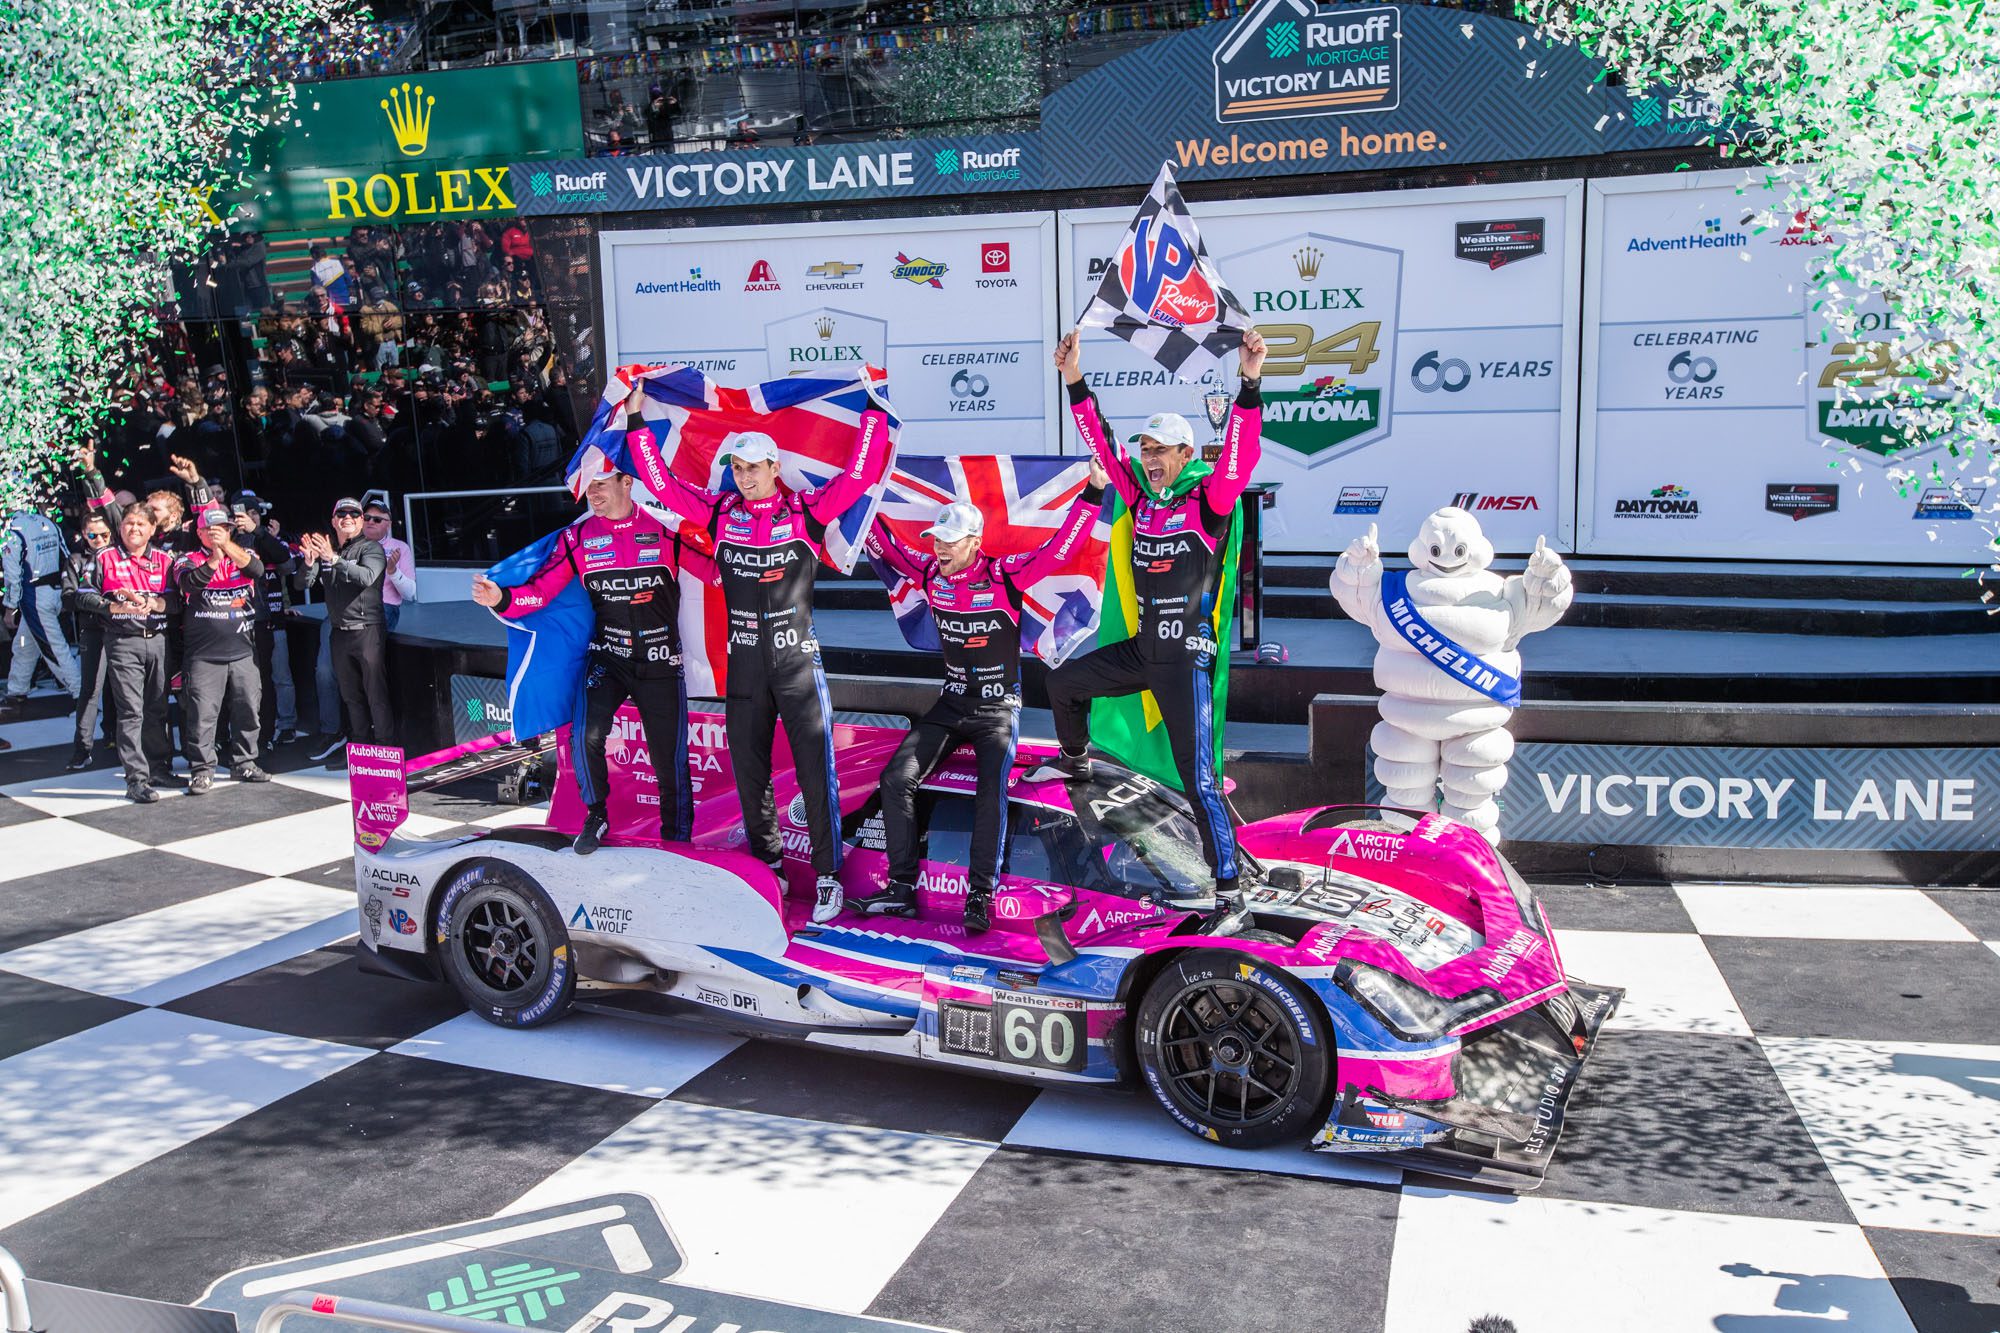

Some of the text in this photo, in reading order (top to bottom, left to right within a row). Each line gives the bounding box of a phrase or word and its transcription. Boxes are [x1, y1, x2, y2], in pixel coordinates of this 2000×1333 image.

[1306, 15, 1390, 49] Ruoff
[1306, 46, 1390, 67] MORTGAGE
[1225, 65, 1391, 98] VICTORY LANE
[1175, 126, 1448, 168] Welcome home.
[963, 148, 1021, 169] Ruoff
[556, 170, 607, 192] Ruoff
[626, 152, 914, 200] VICTORY LANE
[963, 168, 1021, 182] MORTGAGE
[323, 166, 517, 220] ROLEX
[556, 190, 608, 204] MORTGAGE
[895, 264, 947, 279] SUNOCO
[744, 281, 782, 292] AXALTA
[805, 281, 865, 292] CHEVROLET
[975, 279, 1018, 289] TOYOTA
[1156, 284, 1216, 318] Racing
[1253, 288, 1365, 313] ROLEX
[1633, 330, 1759, 347] CELEBRATING
[789, 346, 863, 362] ROLEX
[1237, 321, 1382, 376] 24
[921, 351, 1020, 367] CELEBRATING
[1410, 350, 1554, 394] 60 YEARS
[1664, 386, 1725, 400] YEARS
[948, 399, 996, 413] YEARS
[638, 434, 666, 492] AutoNation
[1476, 496, 1540, 511] IMSA
[1614, 499, 1700, 514] DAYTONA
[732, 549, 799, 568] ACURA
[1146, 559, 1176, 573] S
[601, 575, 665, 592] ACURA
[758, 567, 786, 583] S
[772, 619, 789, 628] JARVIS
[940, 619, 1002, 634] ACURA
[1157, 619, 1184, 640] 60
[738, 631, 759, 640] ARCTIC
[773, 628, 798, 649] 60
[963, 635, 990, 649] S
[647, 645, 670, 662] 60
[1389, 597, 1501, 693] MICHELIN
[981, 682, 1005, 699] 60
[350, 744, 401, 761] AutoNation
[631, 748, 723, 773] ARA
[1537, 772, 1975, 822] VICTORY LANE
[370, 802, 398, 815] ARCTIC
[374, 811, 398, 823] WOLF
[780, 830, 814, 855] CUR
[1354, 832, 1406, 851] ARCTIC
[1360, 846, 1400, 864] WOLF
[371, 869, 421, 887] ACURA
[371, 882, 411, 899] Type S
[440, 869, 480, 918] MICHELIN
[590, 905, 633, 922] ARCTIC
[1388, 900, 1430, 941] ACURA
[597, 919, 629, 934] WOLF
[1479, 930, 1535, 985] AutoNation
[521, 973, 563, 1023] MICHELIN
[696, 990, 758, 1012] AERO DPi
[994, 990, 1084, 1010] WeatherTech
[1262, 977, 1313, 1040] MICHELIN
[1004, 1007, 1075, 1064] 60
[1550, 1064, 1567, 1084] 3D
[1148, 1071, 1196, 1130] MICHELIN
[1365, 1113, 1402, 1127] TUL
[1352, 1133, 1415, 1143] MICHELIN
